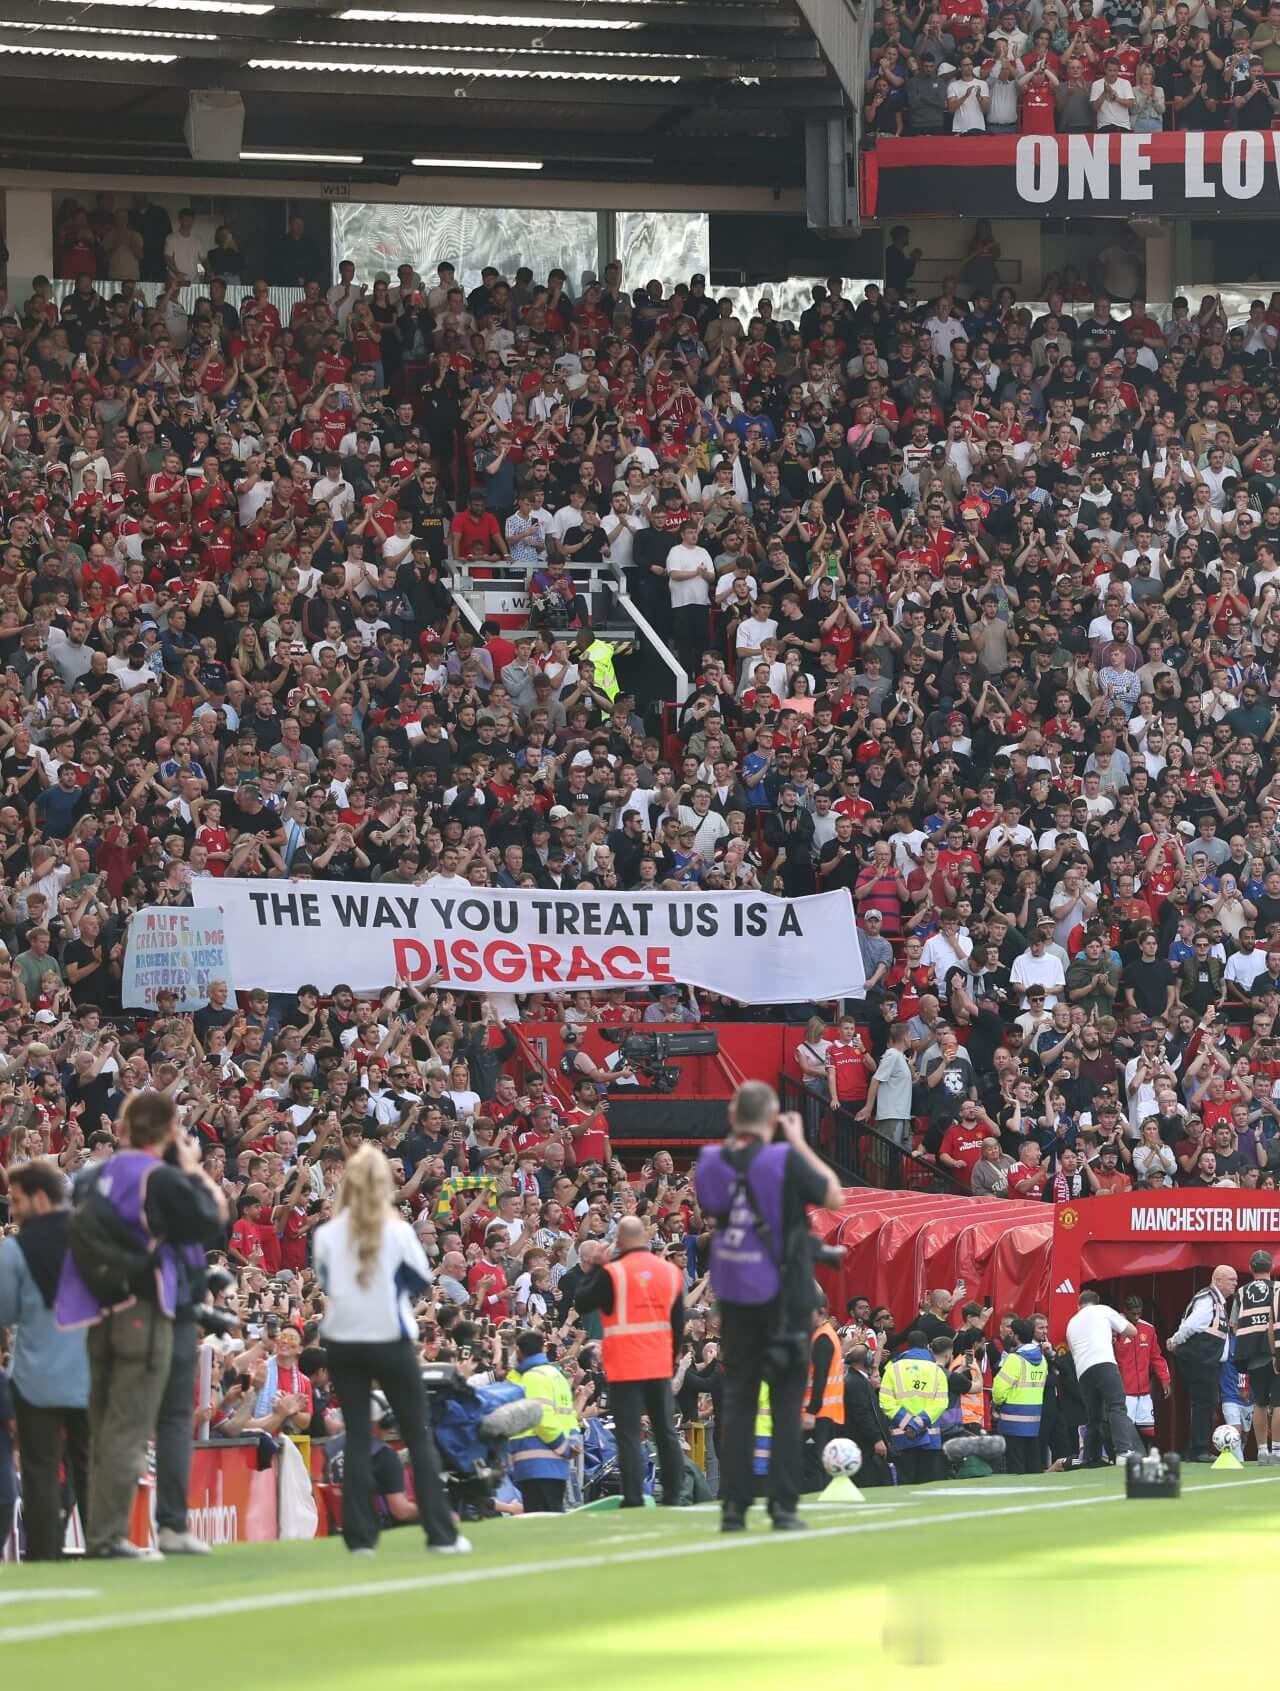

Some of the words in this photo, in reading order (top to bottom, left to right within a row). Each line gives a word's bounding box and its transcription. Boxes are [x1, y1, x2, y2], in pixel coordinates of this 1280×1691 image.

[1016, 134, 1153, 204] ONE
[665, 517, 687, 526] CANA
[512, 598, 530, 609] W2
[249, 892, 321, 926] THE
[332, 894, 418, 929] WAY
[431, 898, 518, 933] YOU
[532, 901, 652, 936] TREAT
[669, 903, 718, 937] US
[734, 903, 767, 937] IS
[778, 903, 803, 936] A
[395, 938, 675, 983] DISGRACE
[1131, 1208, 1233, 1231] MANCHESTER
[1251, 1315, 1268, 1325] 312
